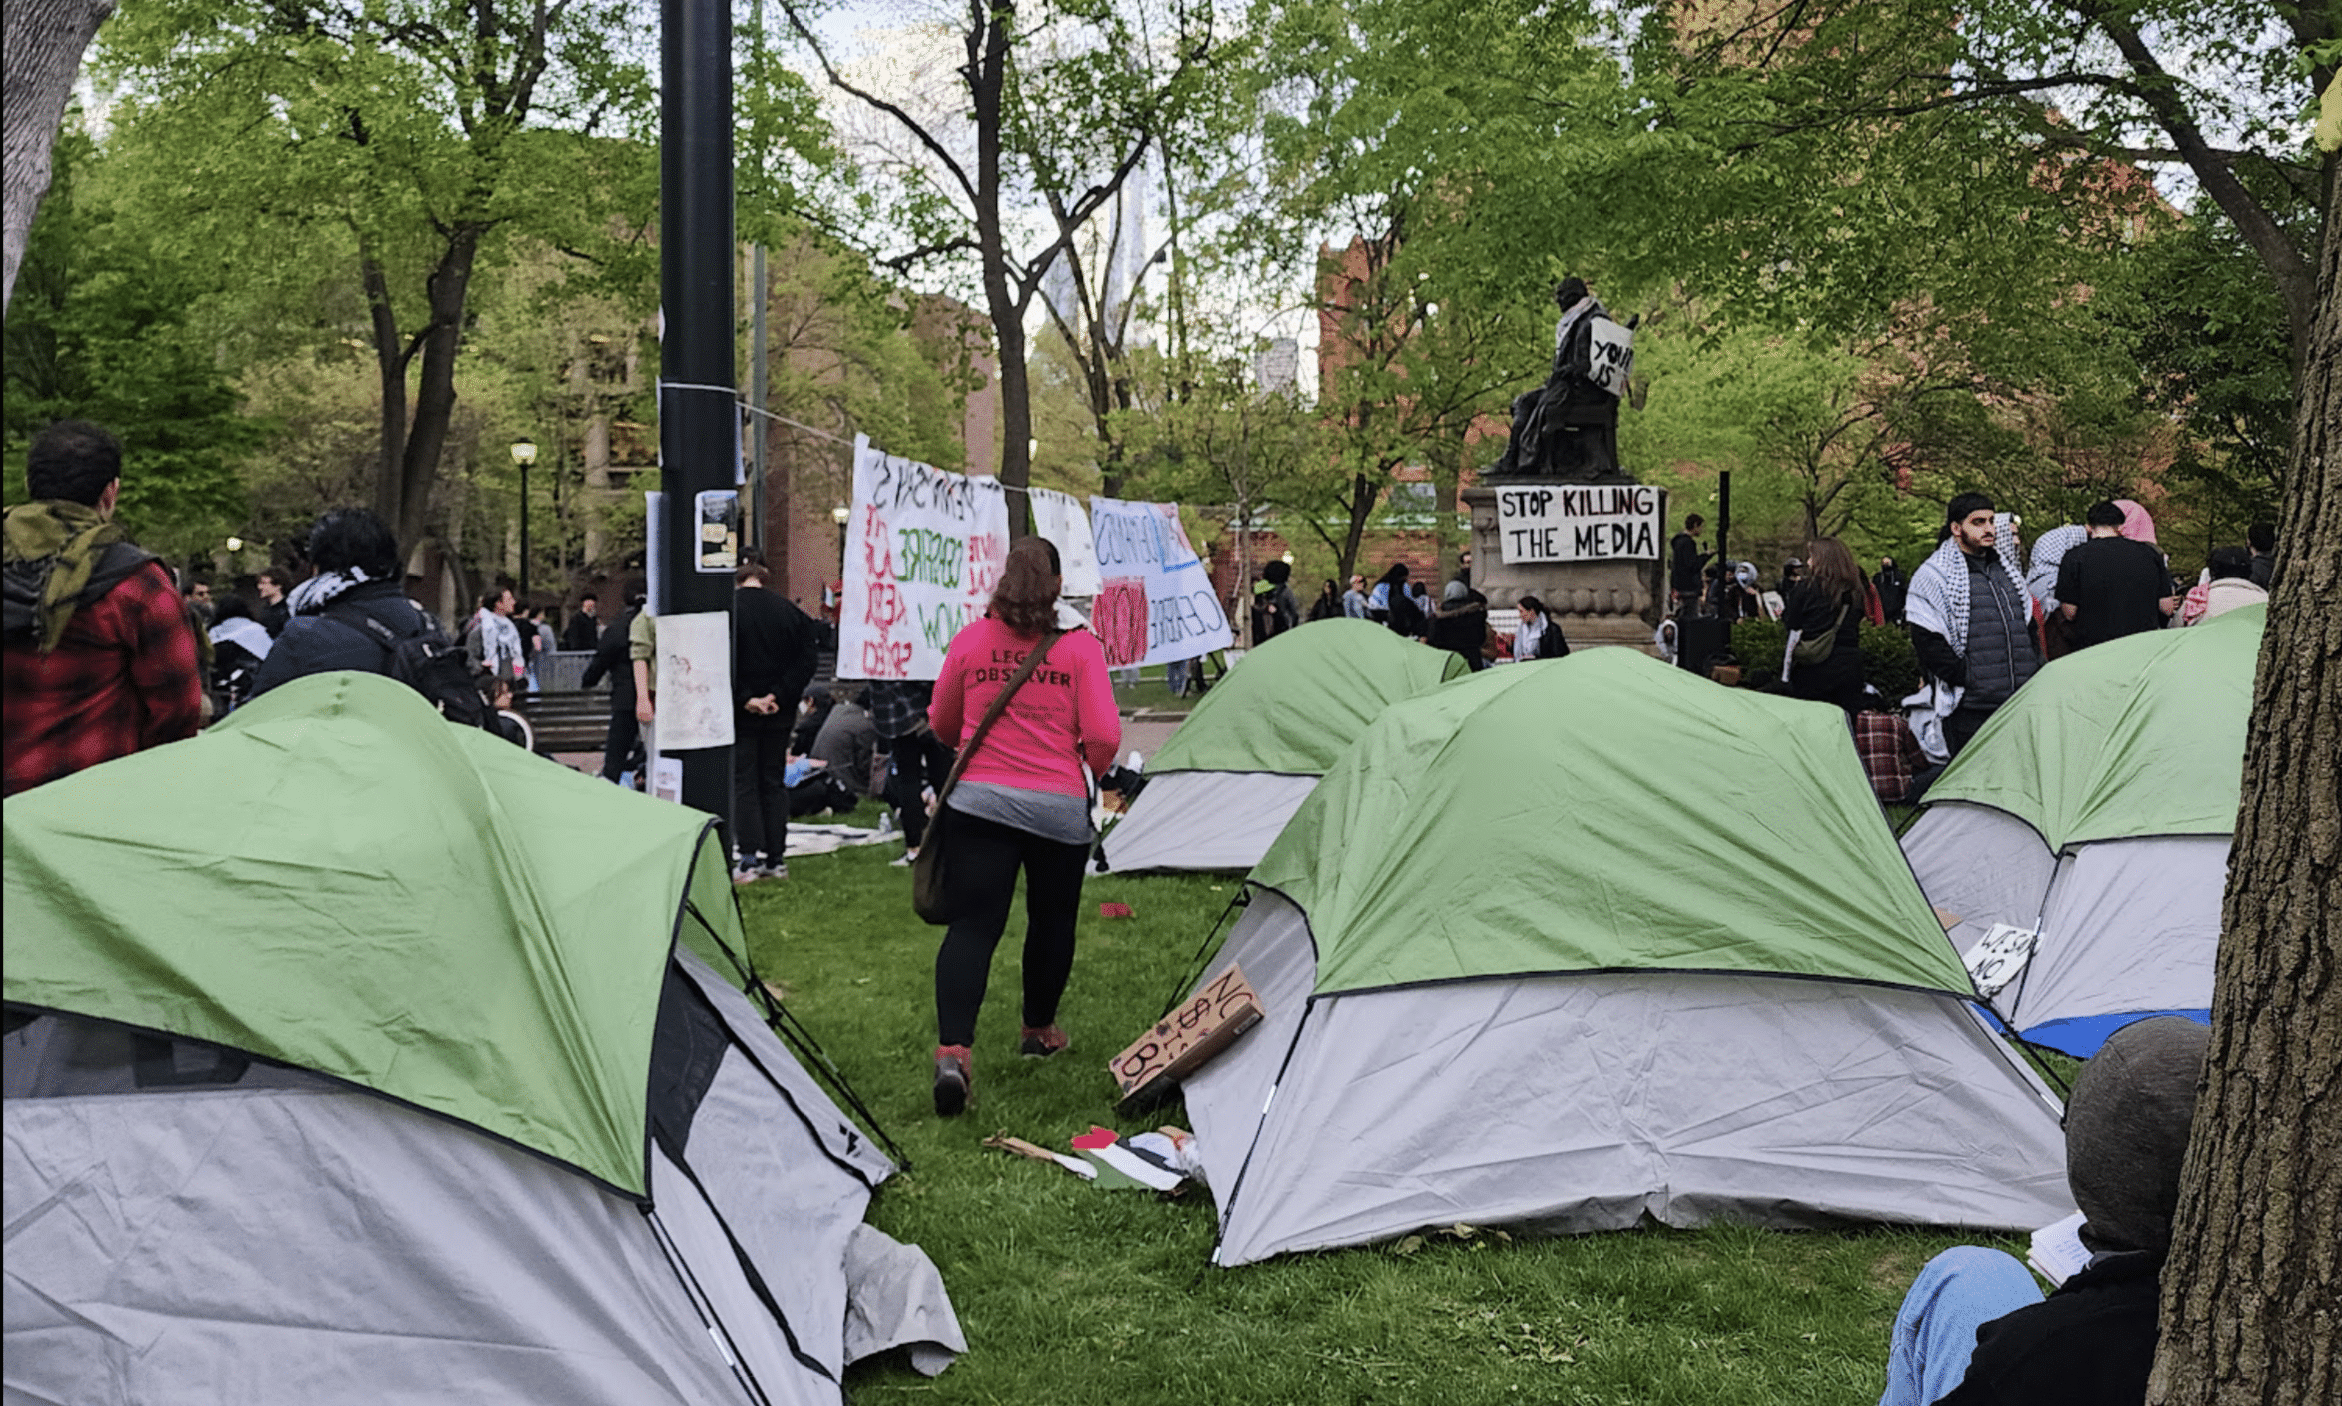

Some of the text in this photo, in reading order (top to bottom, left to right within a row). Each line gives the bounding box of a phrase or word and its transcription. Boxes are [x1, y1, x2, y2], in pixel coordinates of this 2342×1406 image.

[1502, 487, 1653, 518] STOP KILLING
[1509, 521, 1655, 558] THE MEDIA
[992, 649, 1052, 666] LEGL
[976, 667, 1071, 688] OBSVER
